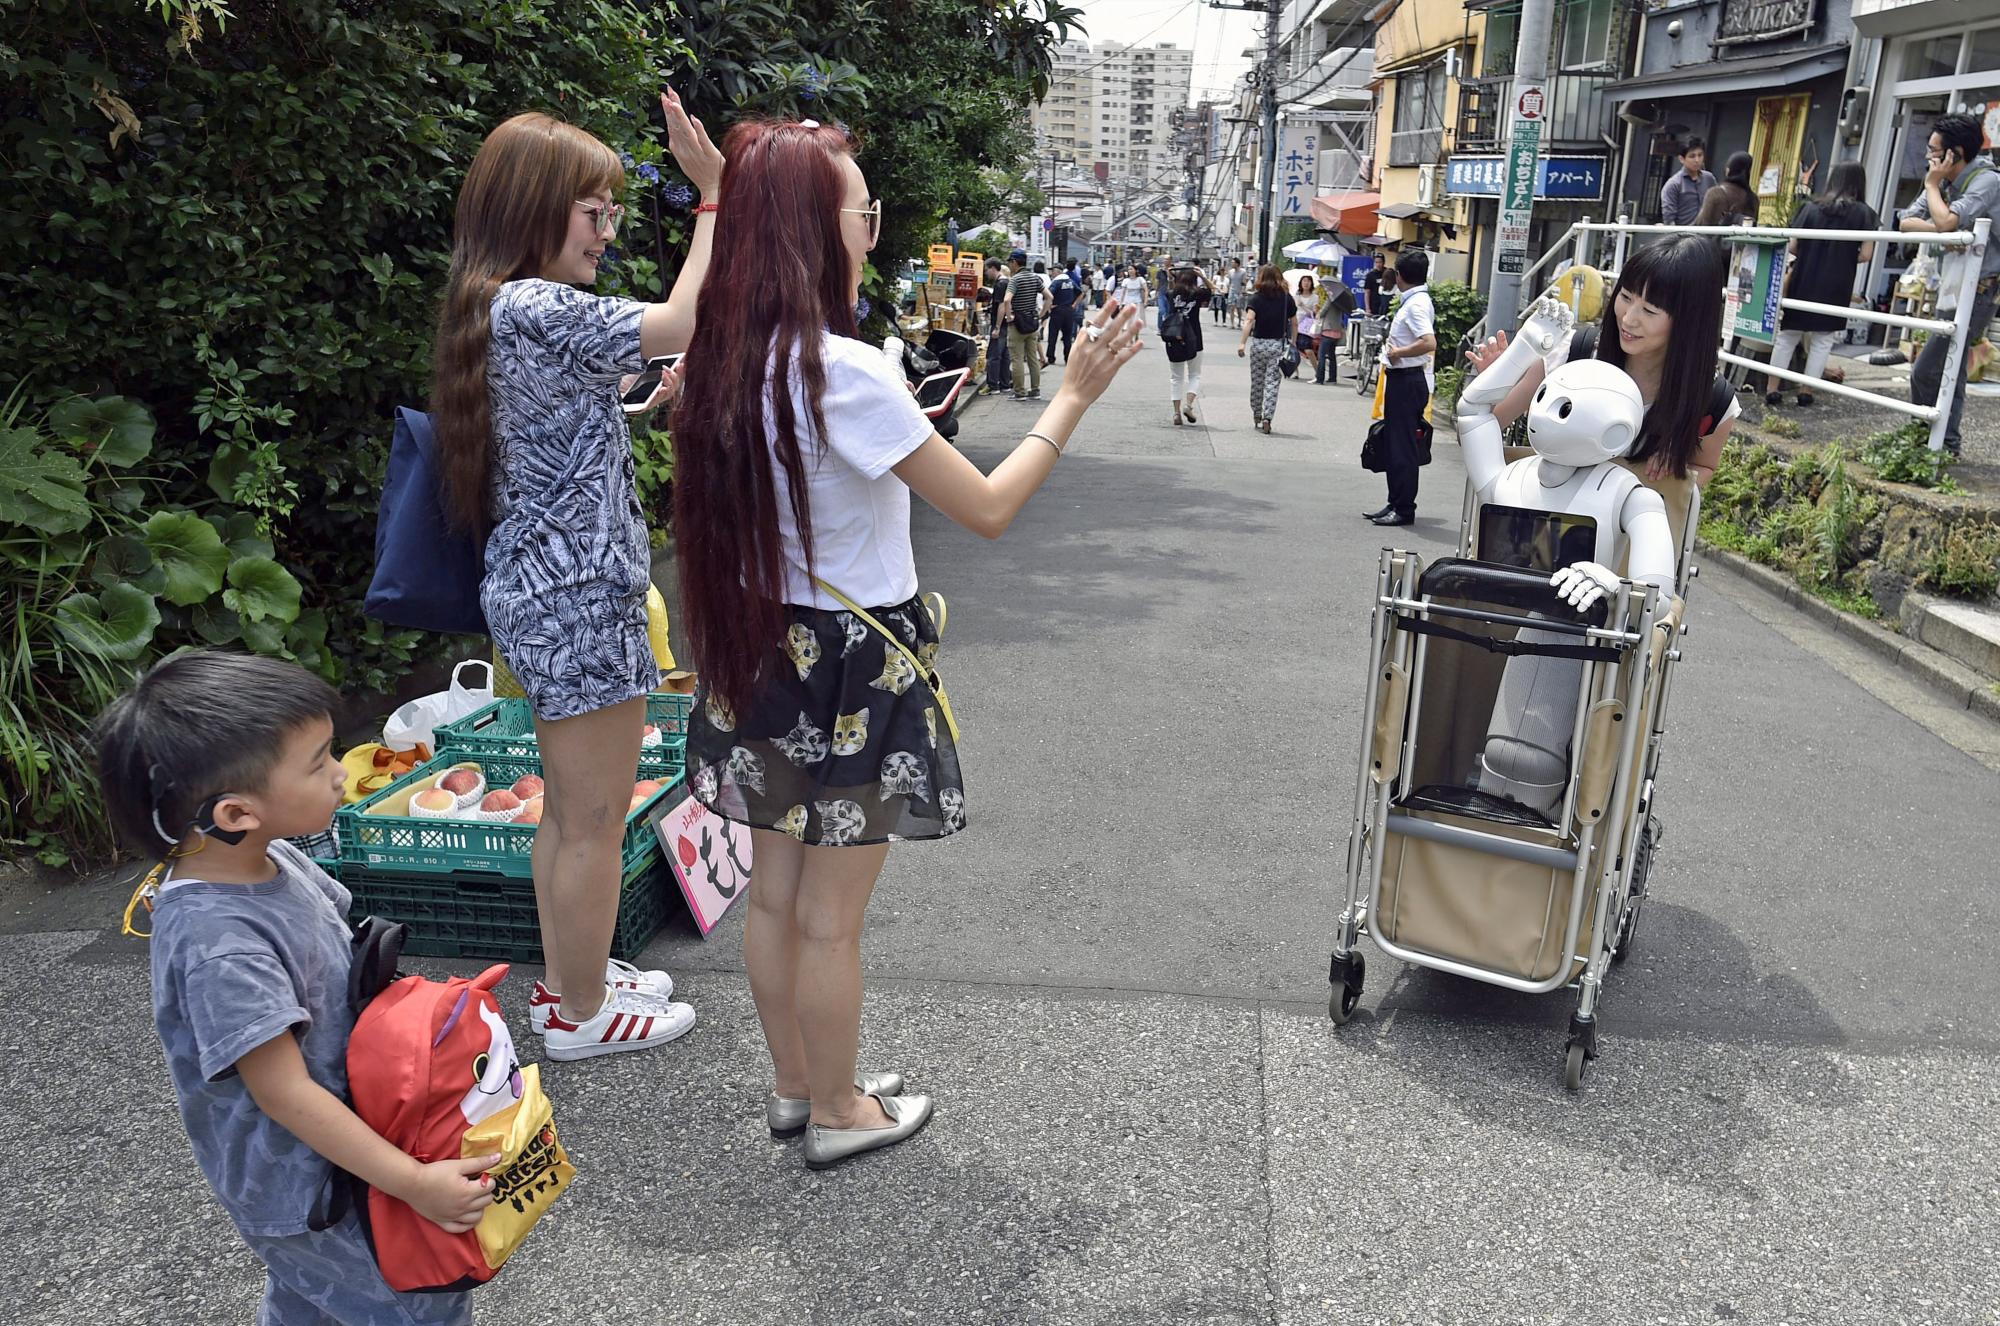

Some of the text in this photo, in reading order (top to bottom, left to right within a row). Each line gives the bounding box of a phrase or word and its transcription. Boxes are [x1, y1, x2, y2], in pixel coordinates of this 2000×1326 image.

[1284, 149, 1304, 214] ホテル
[1547, 170, 1594, 186] アパート
